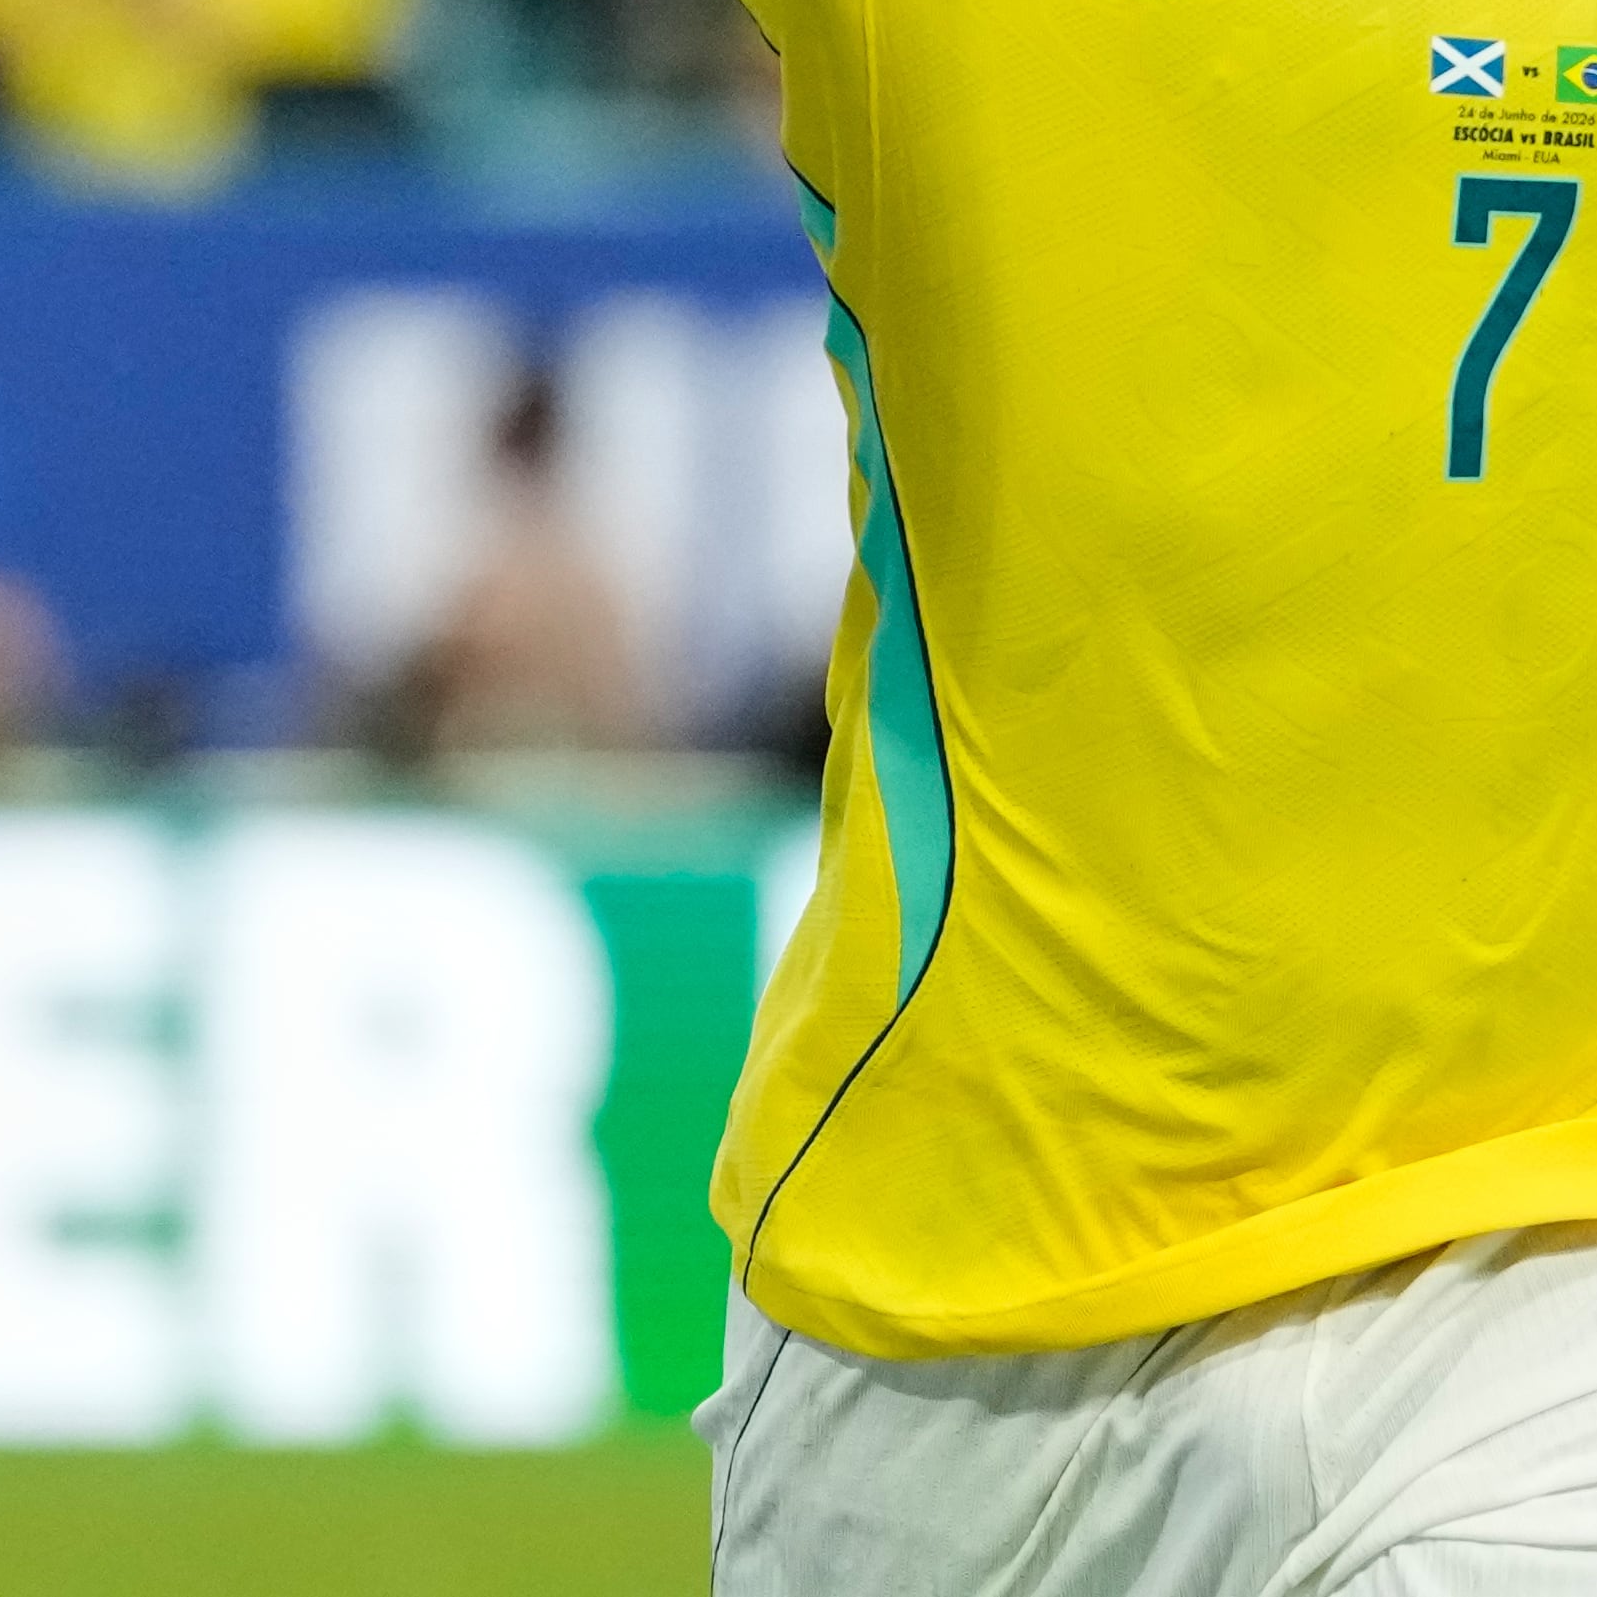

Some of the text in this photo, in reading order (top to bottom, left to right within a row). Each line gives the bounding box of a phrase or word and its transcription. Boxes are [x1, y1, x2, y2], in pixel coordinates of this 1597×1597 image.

[1522, 66, 1539, 77] vs
[1458, 106, 1595, 126] 24 de Junho de 2026
[1454, 123, 1595, 148] ESCÓCIA vs BRASIL
[1482, 149, 1521, 161] Miami
[1533, 151, 1560, 164] EUA
[1444, 173, 1582, 482] 7
